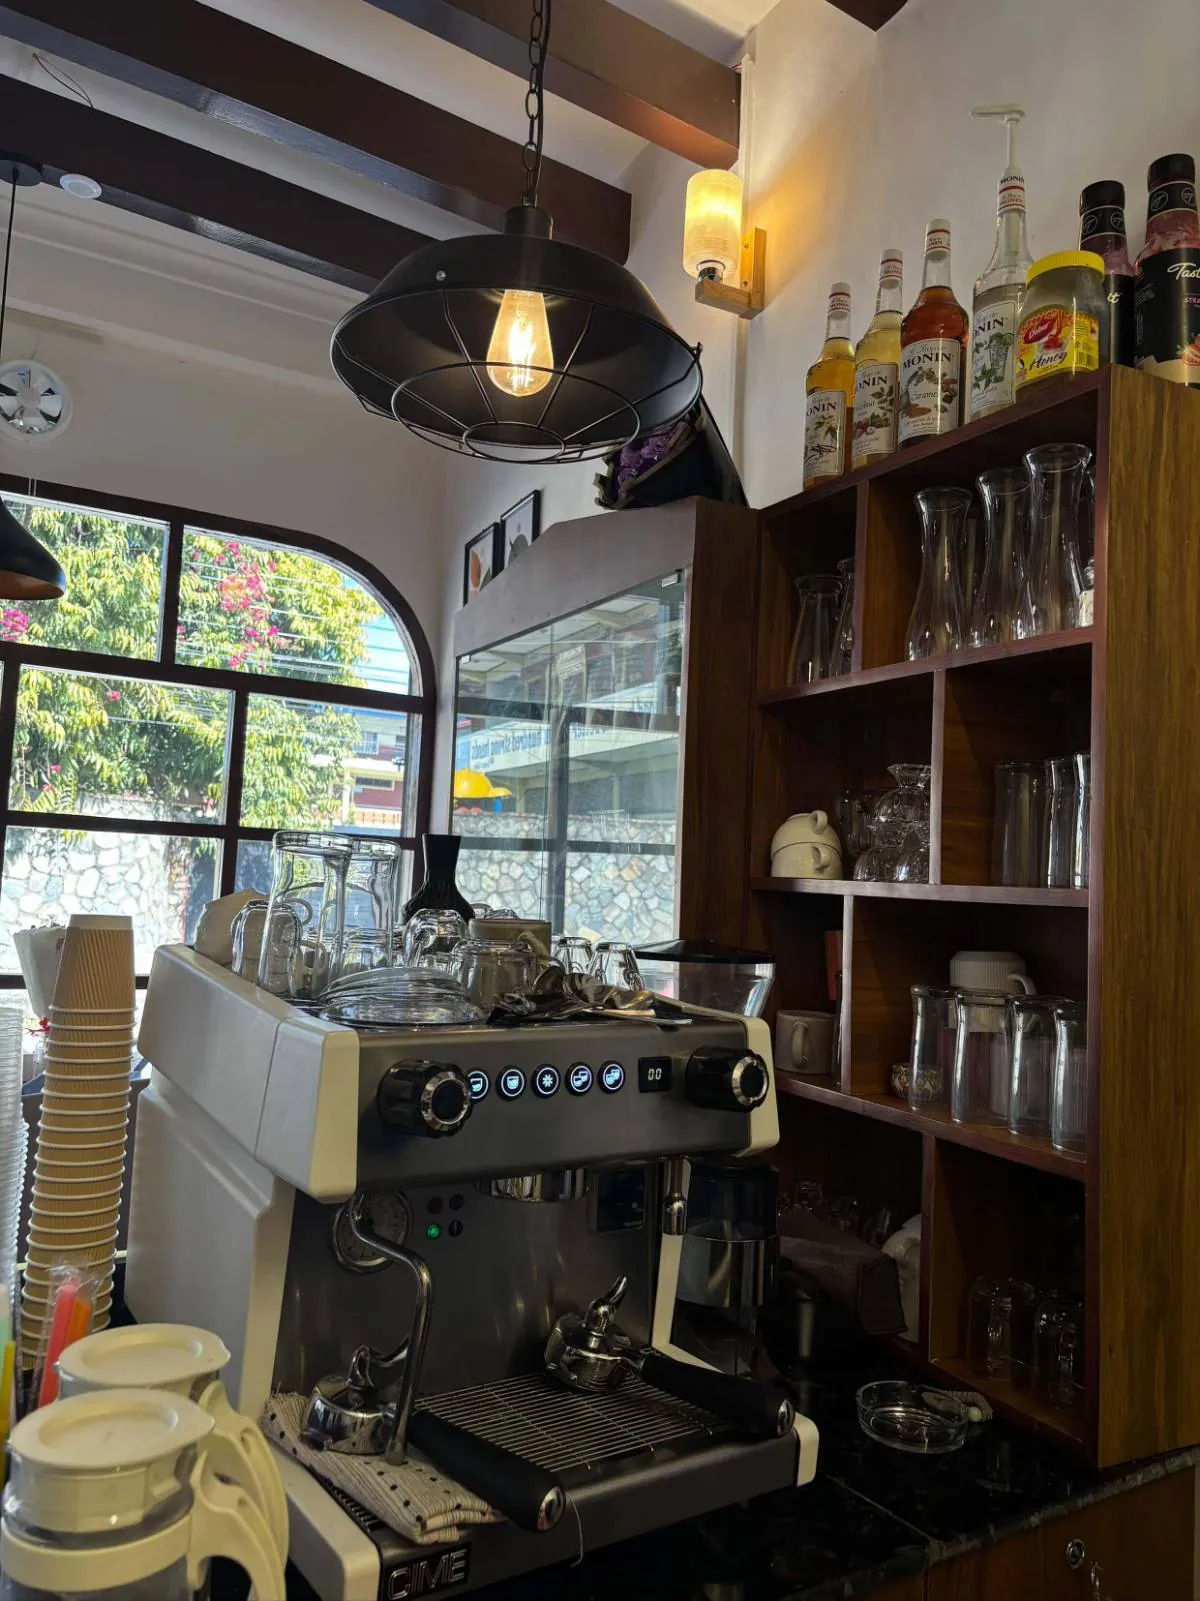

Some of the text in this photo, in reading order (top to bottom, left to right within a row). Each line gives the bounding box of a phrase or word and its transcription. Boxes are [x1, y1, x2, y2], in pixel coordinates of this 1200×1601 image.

[903, 353, 951, 370] MONIN
[1029, 351, 1067, 371] Honey
[648, 1068, 662, 1080] 00
[388, 1548, 468, 1600] CIME
